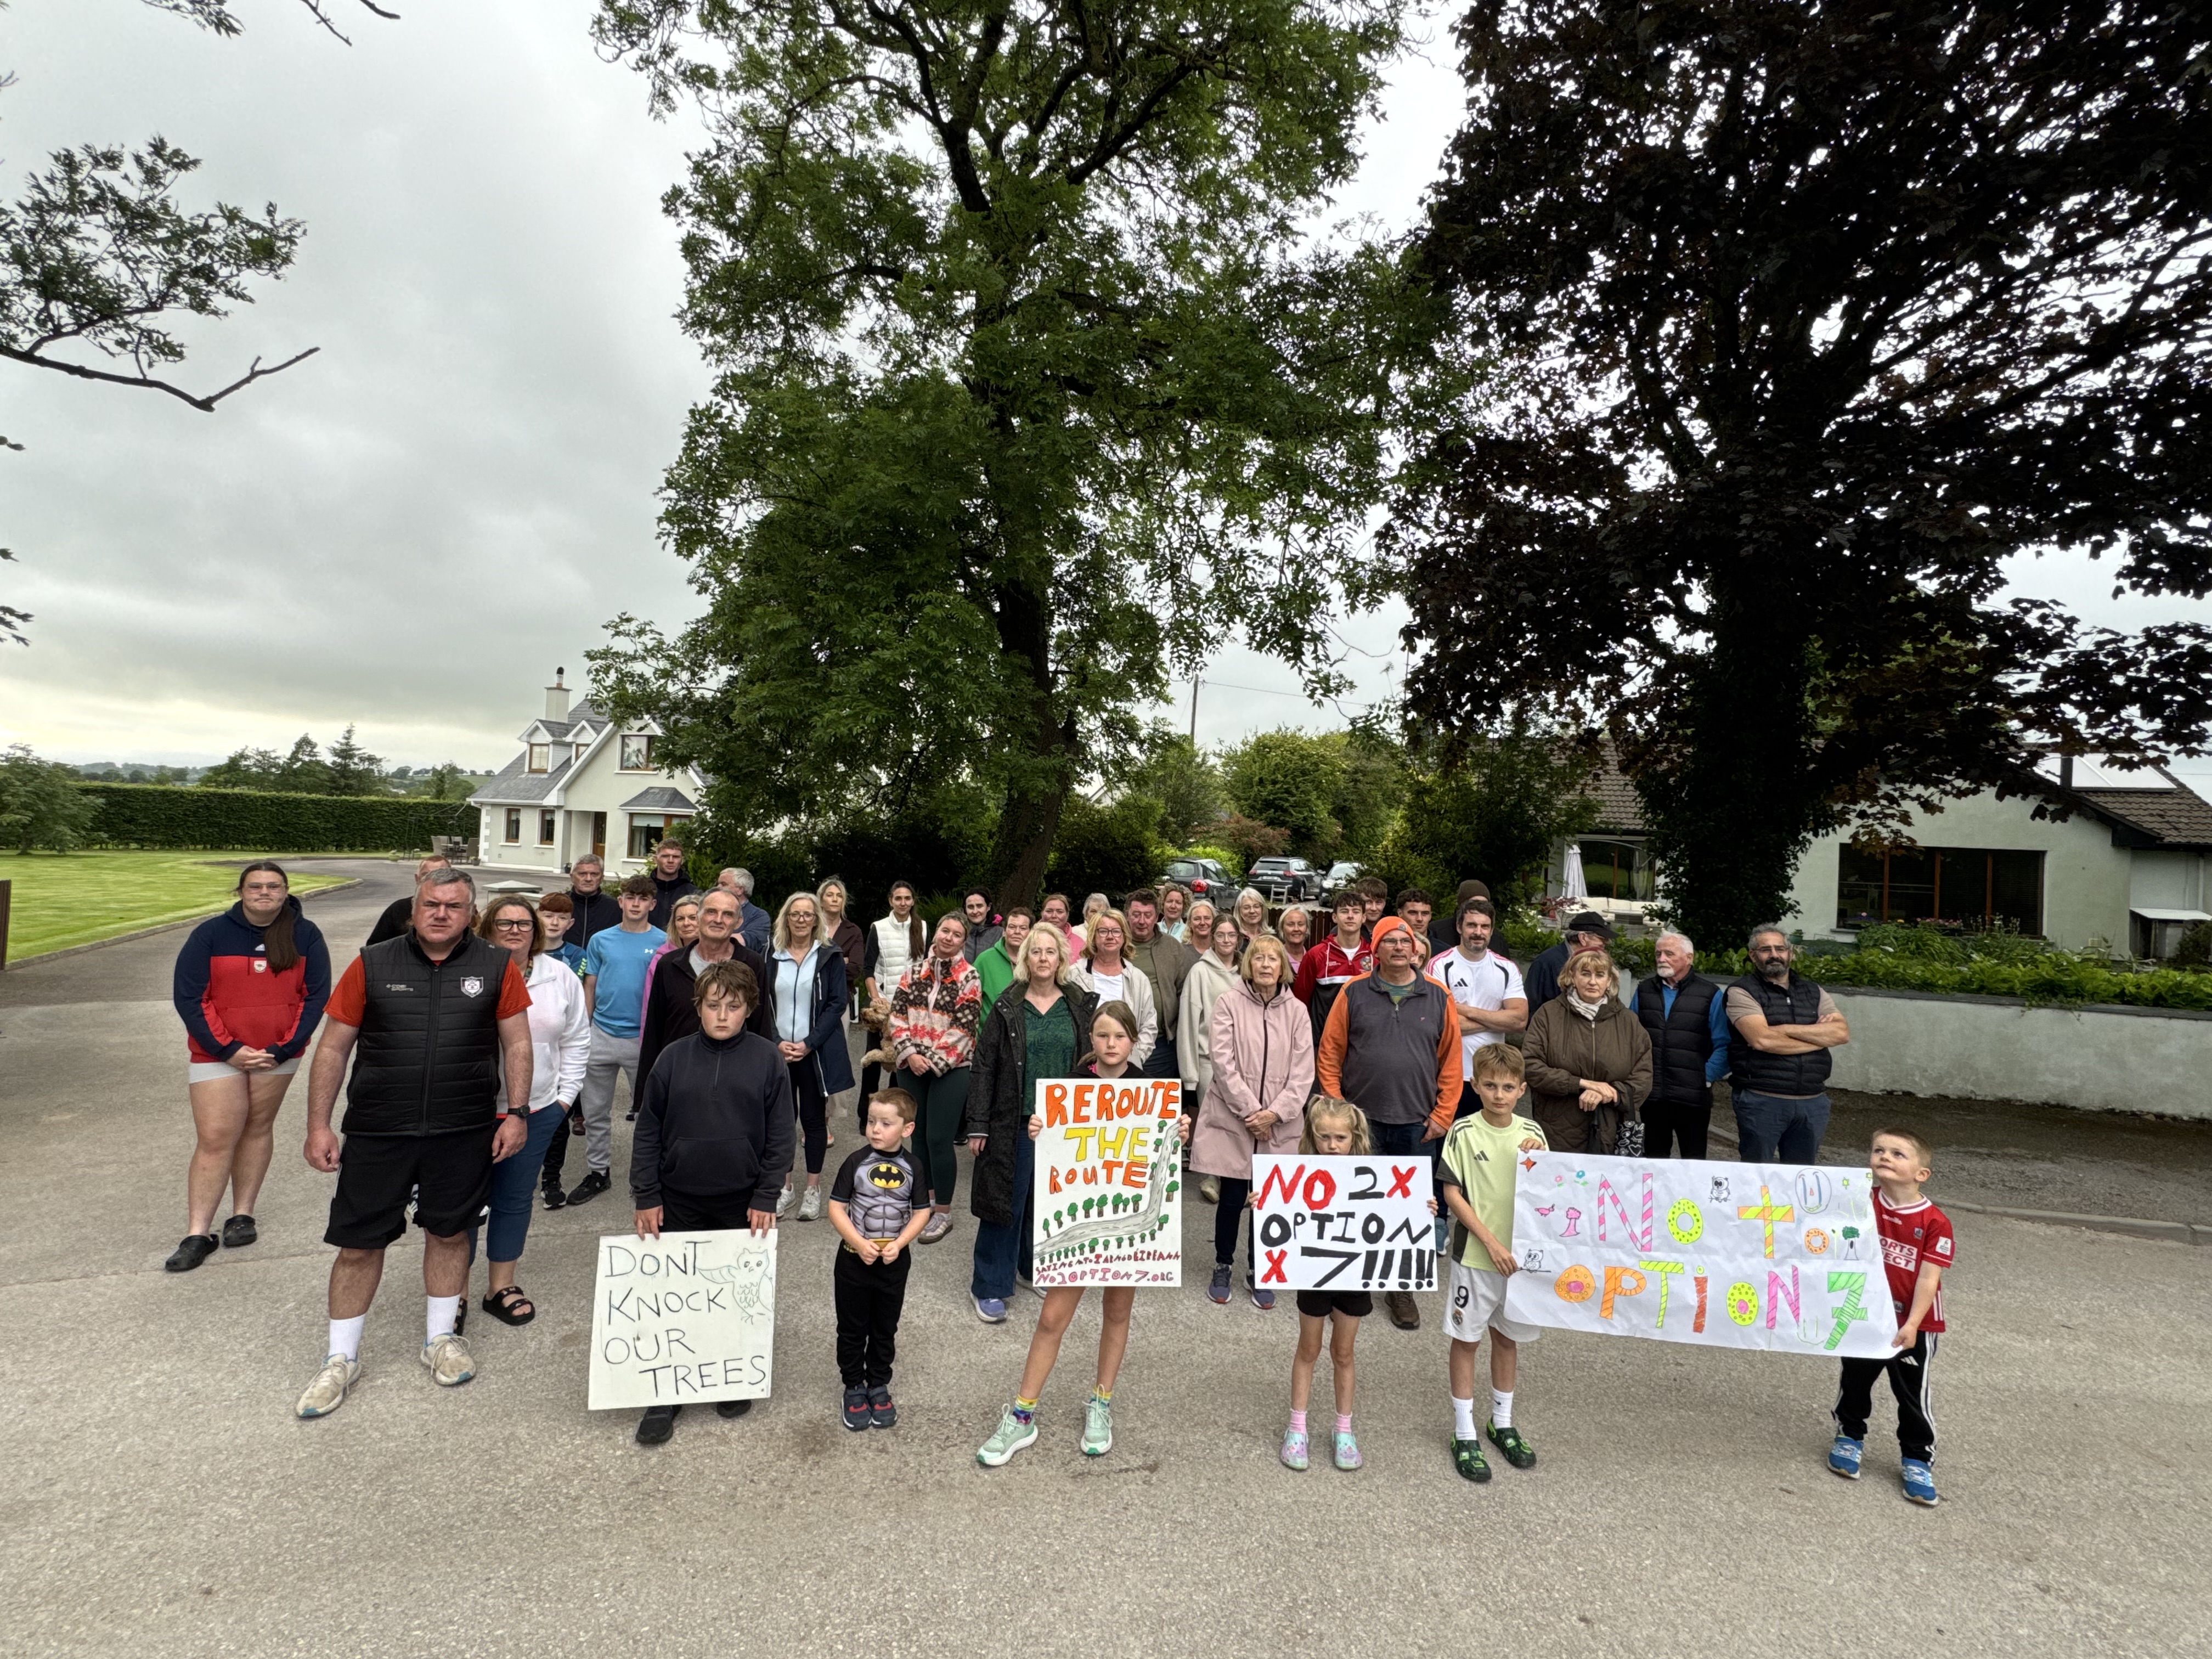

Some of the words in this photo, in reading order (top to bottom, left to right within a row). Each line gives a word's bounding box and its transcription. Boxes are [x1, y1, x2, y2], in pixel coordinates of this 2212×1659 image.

[1046, 1081, 1180, 1128] REROUTE
[1064, 1127, 1150, 1163] THE
[1049, 1160, 1150, 1194] ROUTE
[1256, 1163, 1336, 1210] NO
[1260, 1211, 1432, 1248] OPTION
[608, 1287, 726, 1325] KNOCK
[1454, 1285, 1469, 1308] 9
[605, 1328, 696, 1364] OUR
